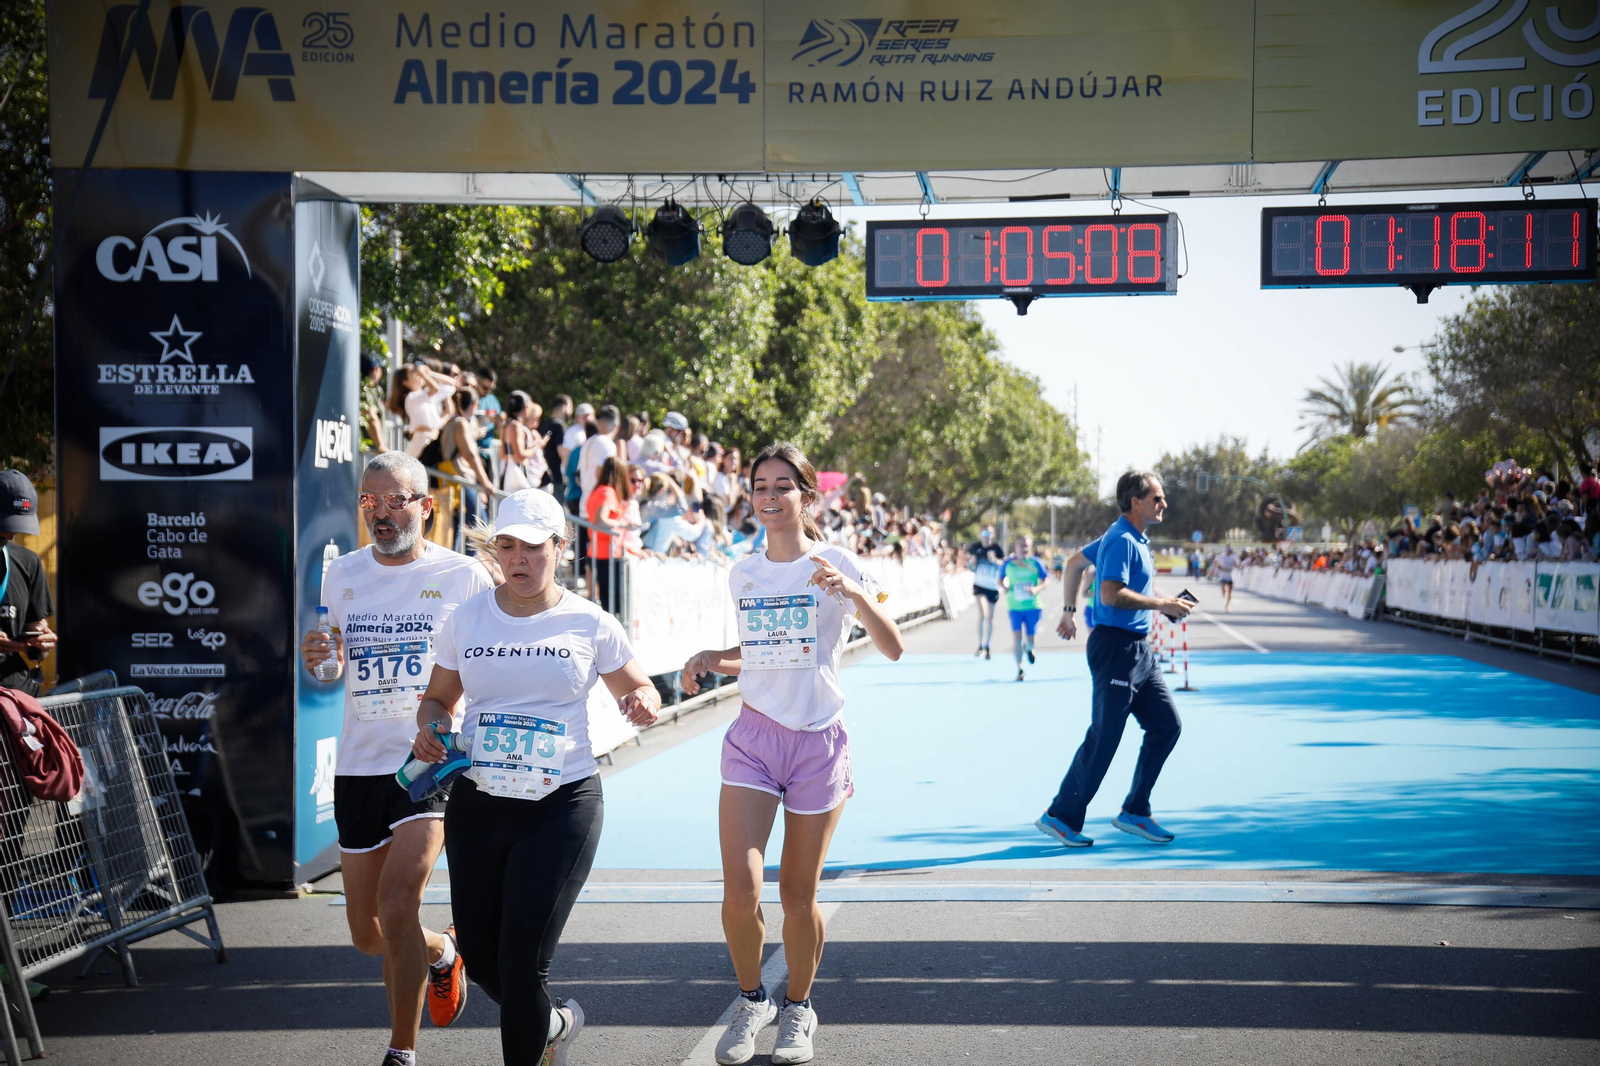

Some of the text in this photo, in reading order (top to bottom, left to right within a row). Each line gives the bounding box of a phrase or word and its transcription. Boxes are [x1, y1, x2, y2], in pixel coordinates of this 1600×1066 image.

[302, 12, 354, 49] 25
[395, 12, 755, 50] Medio Maratón
[883, 18, 959, 37] RFEA
[875, 38, 951, 52] SERIES
[301, 50, 355, 63] EDICIÓN
[869, 52, 996, 66] RUTA RUNNING
[393, 58, 757, 105] Almería 2024
[788, 71, 1164, 103] RAMÓN RUIZ ANDÚJAR
[1315, 211, 1580, 277] 01:18:11
[96, 235, 219, 282] CASI
[309, 297, 351, 323] COOPERACIÓN
[309, 313, 326, 334] 2005
[97, 364, 255, 384] ESTRELLA
[134, 384, 220, 395] DE LEVANTE
[121, 442, 236, 465] IKEA
[147, 512, 206, 527] Barceló
[147, 529, 208, 543] Cabo de
[147, 545, 183, 559] Gata
[137, 571, 216, 616] ego
[347, 613, 433, 622] Medio Maratón
[747, 607, 809, 632] 5349
[345, 622, 434, 634] Almería 2024
[131, 632, 175, 648] SER
[200, 631, 227, 651] 40
[346, 635, 371, 643] RAMÓN
[464, 646, 571, 659] COSENTINO
[132, 663, 223, 675] La Voz de Almería
[357, 655, 422, 681] 5176
[482, 727, 556, 758] 5313
[506, 753, 523, 761] ANA
